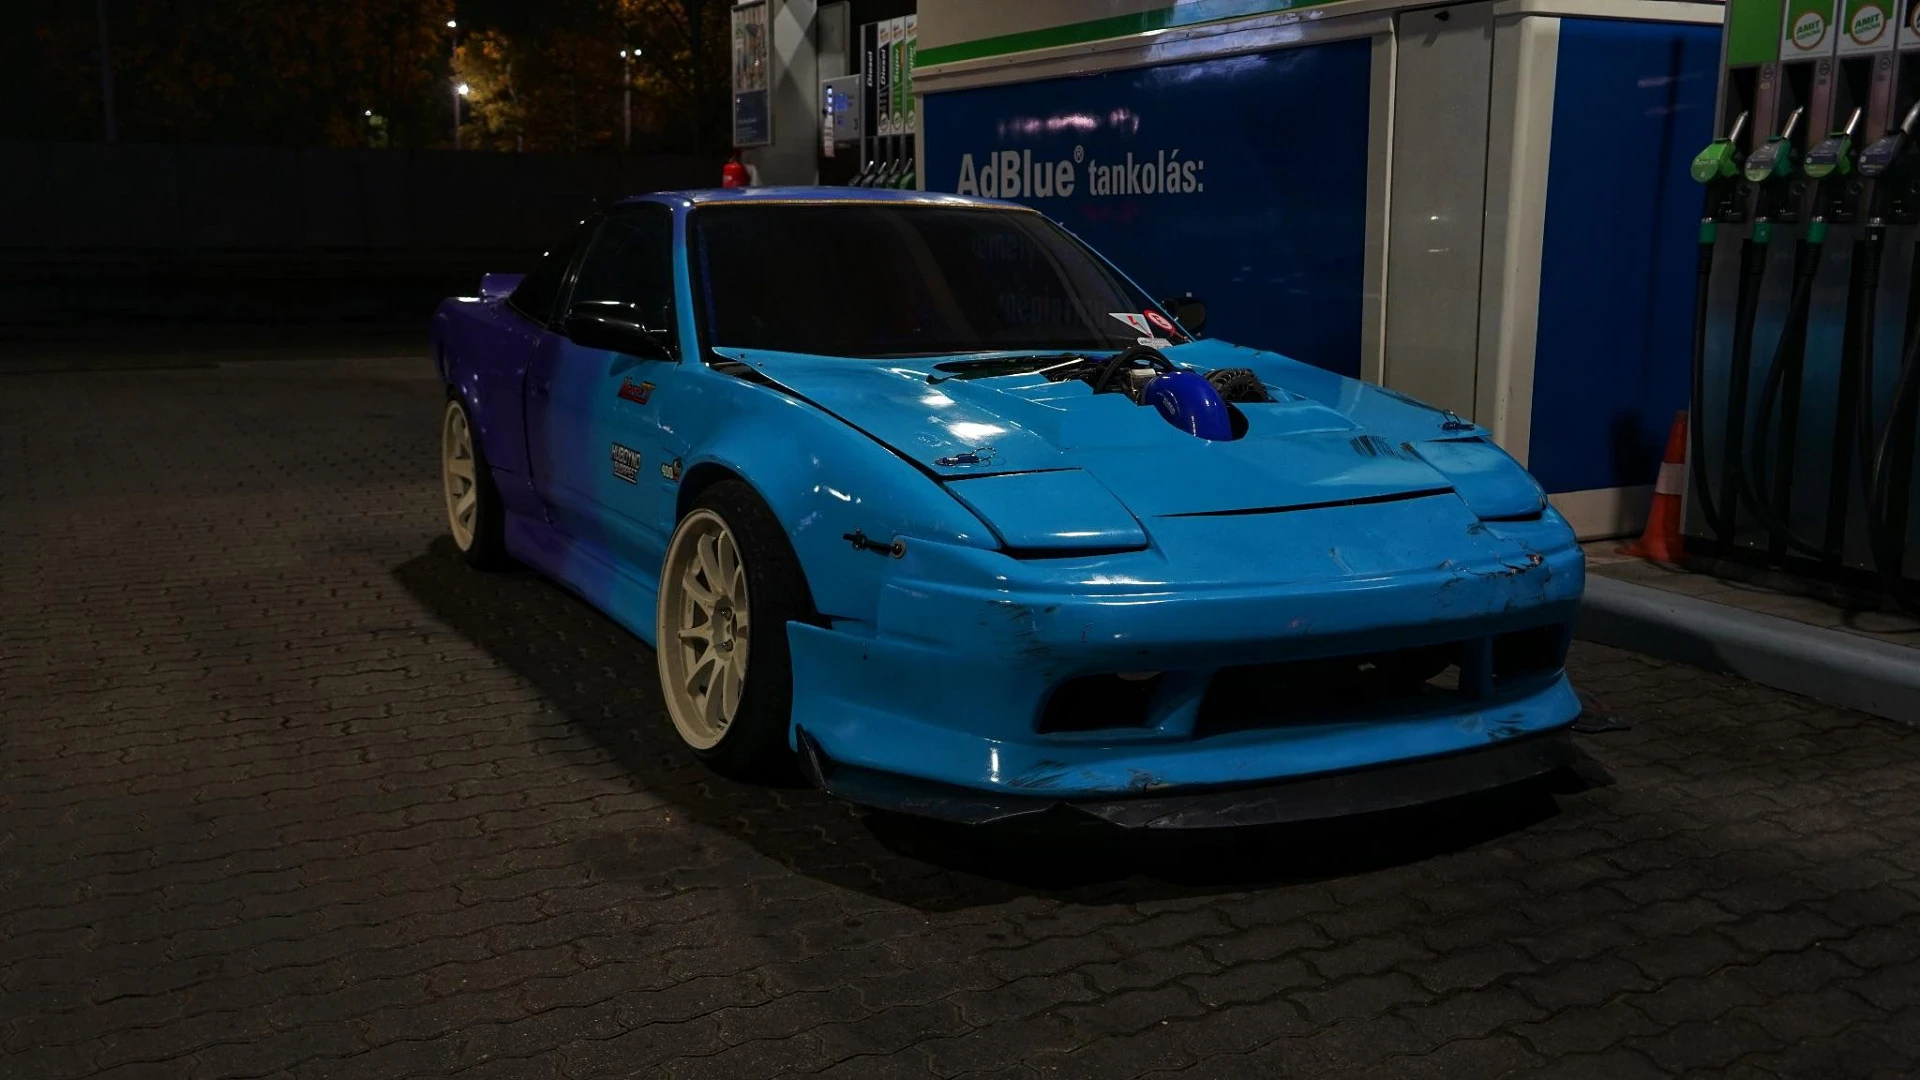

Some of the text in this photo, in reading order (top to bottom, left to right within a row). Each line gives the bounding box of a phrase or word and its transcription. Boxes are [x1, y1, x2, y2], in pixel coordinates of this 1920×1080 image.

[1797, 20, 1821, 34] AMIT
[1855, 13, 1881, 29] AMIT
[1088, 149, 1204, 196] tankolás:
